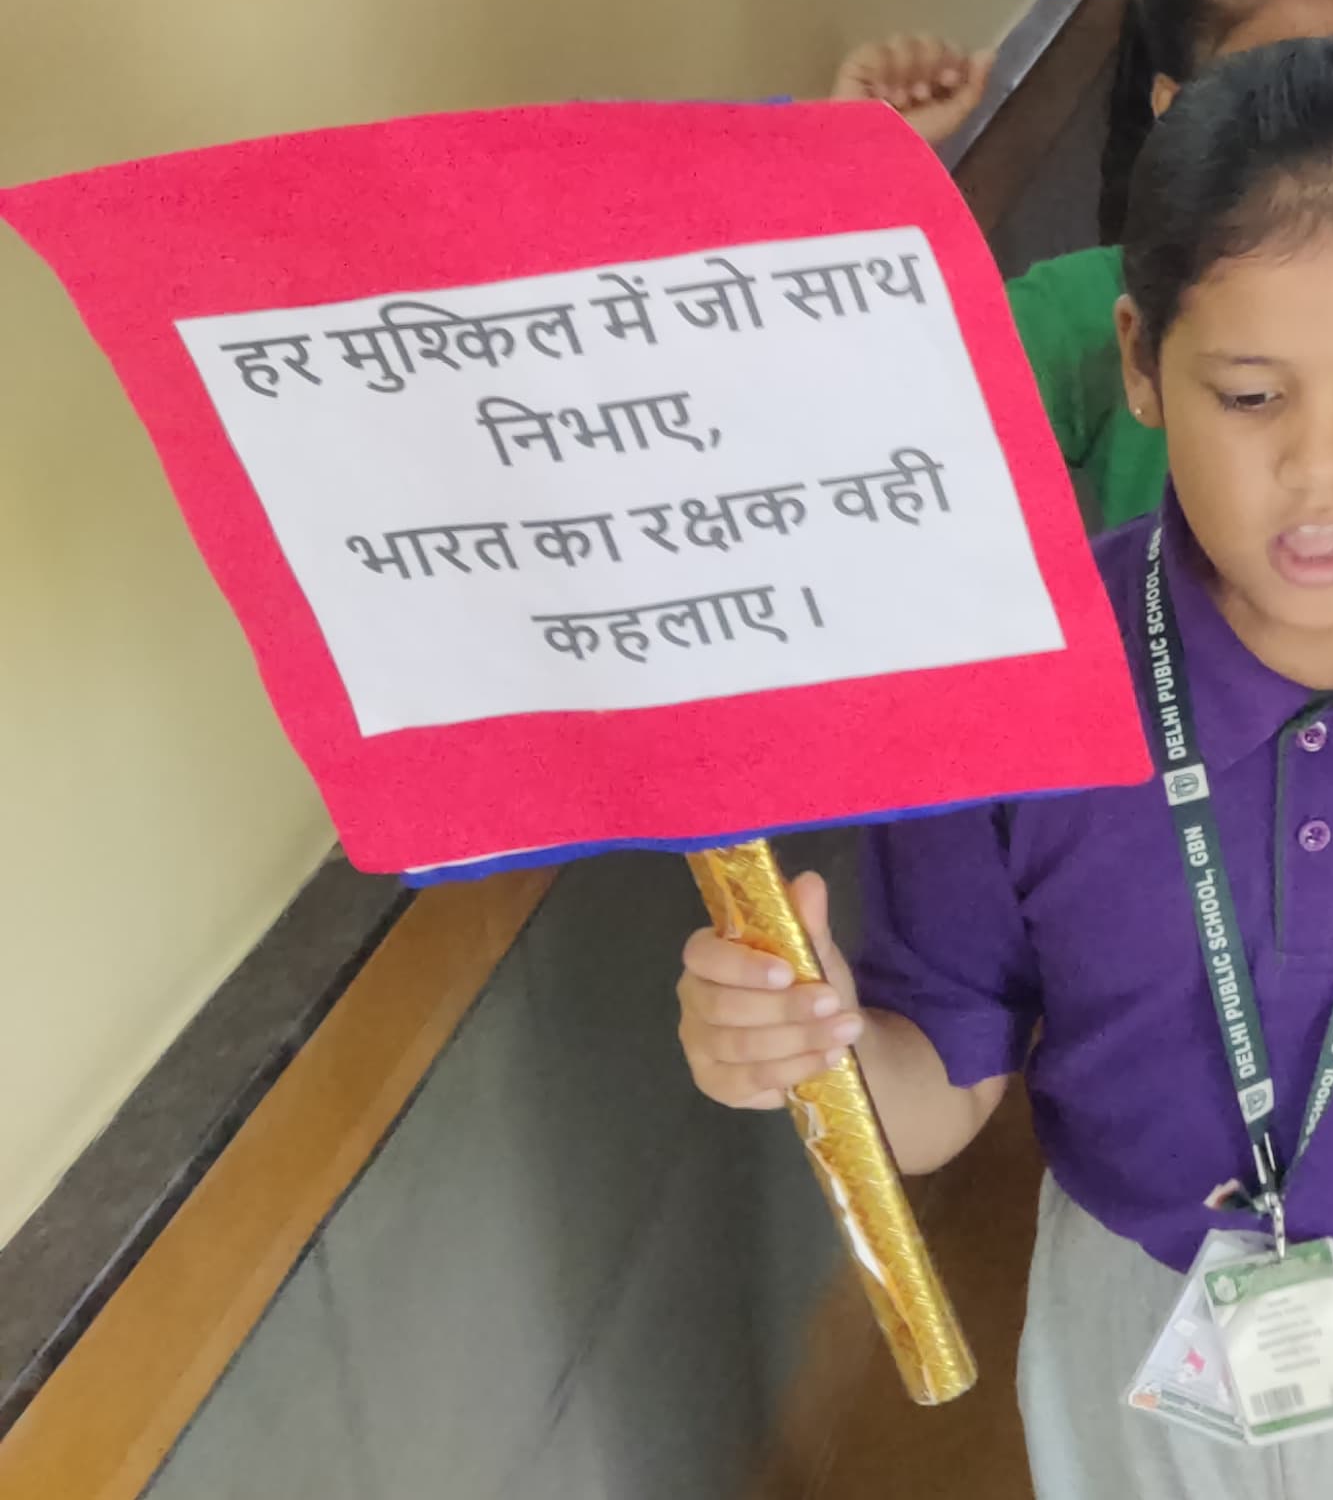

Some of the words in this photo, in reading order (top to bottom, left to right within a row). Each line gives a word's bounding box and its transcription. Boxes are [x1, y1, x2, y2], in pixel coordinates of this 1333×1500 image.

[220, 334, 323, 398] हर
[325, 300, 584, 392] मुश्किल
[590, 273, 658, 346] में
[666, 258, 763, 333] जो
[771, 252, 929, 321] साथ
[476, 392, 722, 467] निभाए,
[346, 521, 518, 581] भारत
[521, 512, 622, 570] का
[627, 482, 808, 554] रक्षक
[818, 448, 951, 526] वही
[531, 584, 788, 664] कहलाए
[1150, 636, 1178, 704] PUBLIC
[1160, 700, 1187, 760] DELHI
[1184, 824, 1209, 867] GBN
[1196, 867, 1231, 952] SCHOOL,
[1212, 951, 1244, 1023] PUBLIC
[1228, 1022, 1257, 1080] DELHI
